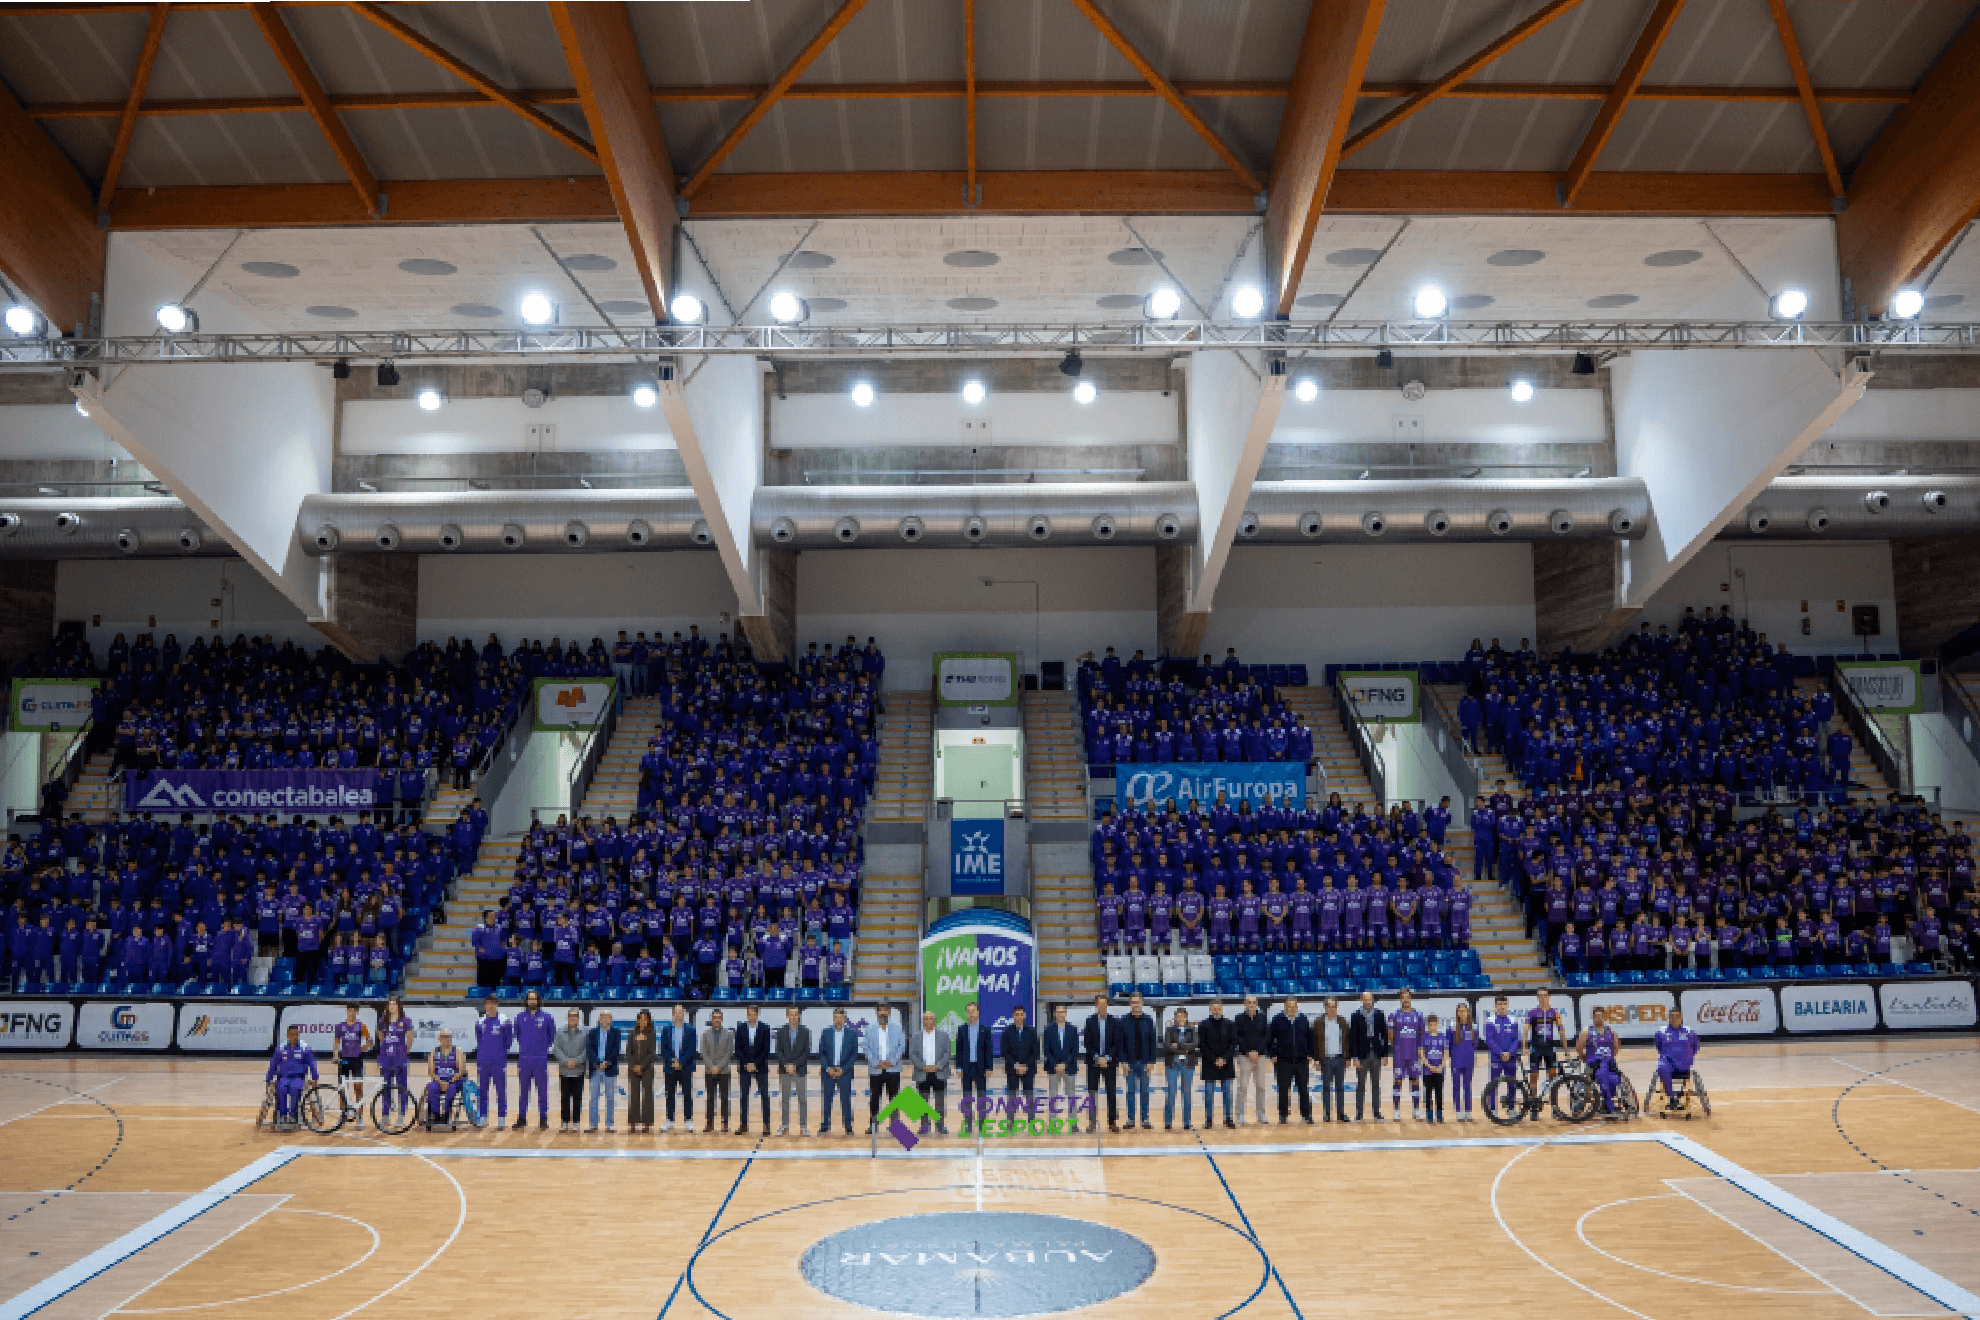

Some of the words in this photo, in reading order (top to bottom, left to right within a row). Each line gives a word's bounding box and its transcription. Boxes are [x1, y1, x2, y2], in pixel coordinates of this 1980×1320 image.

[1369, 688, 1404, 702] FNG
[213, 785, 374, 806] conectabalea
[956, 852, 1000, 874] IME
[935, 946, 1018, 971] ¡VAMOS
[935, 971, 1020, 995] PALMA!
[1795, 1000, 1867, 1016] BALEARIA
[10, 1012, 61, 1032] FNG
[959, 1096, 1096, 1113] CONNECTA
[958, 1118, 1080, 1138] L'ESPORT
